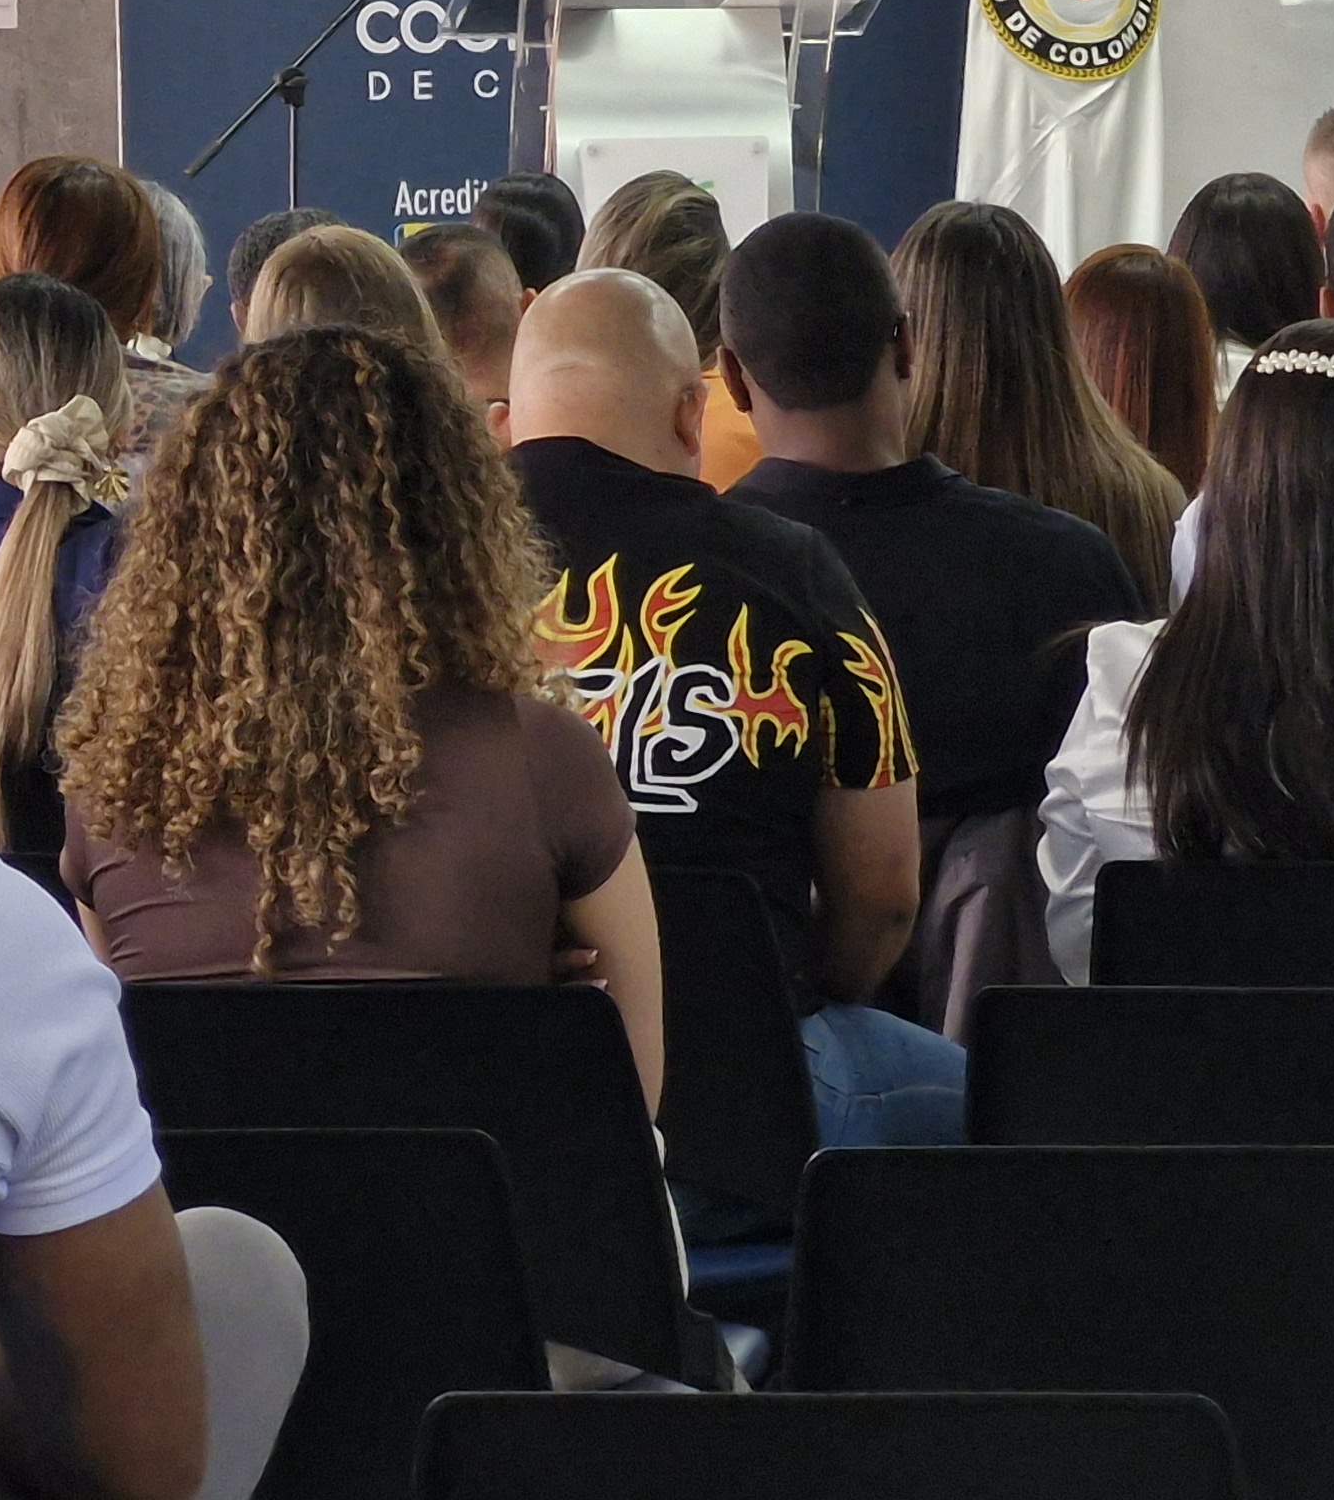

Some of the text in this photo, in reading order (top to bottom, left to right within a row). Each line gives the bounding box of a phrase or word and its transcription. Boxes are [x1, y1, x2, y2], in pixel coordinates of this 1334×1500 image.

[1005, 10, 1042, 49] DE
[368, 70, 433, 101] DE
[394, 178, 488, 217] Acredi
